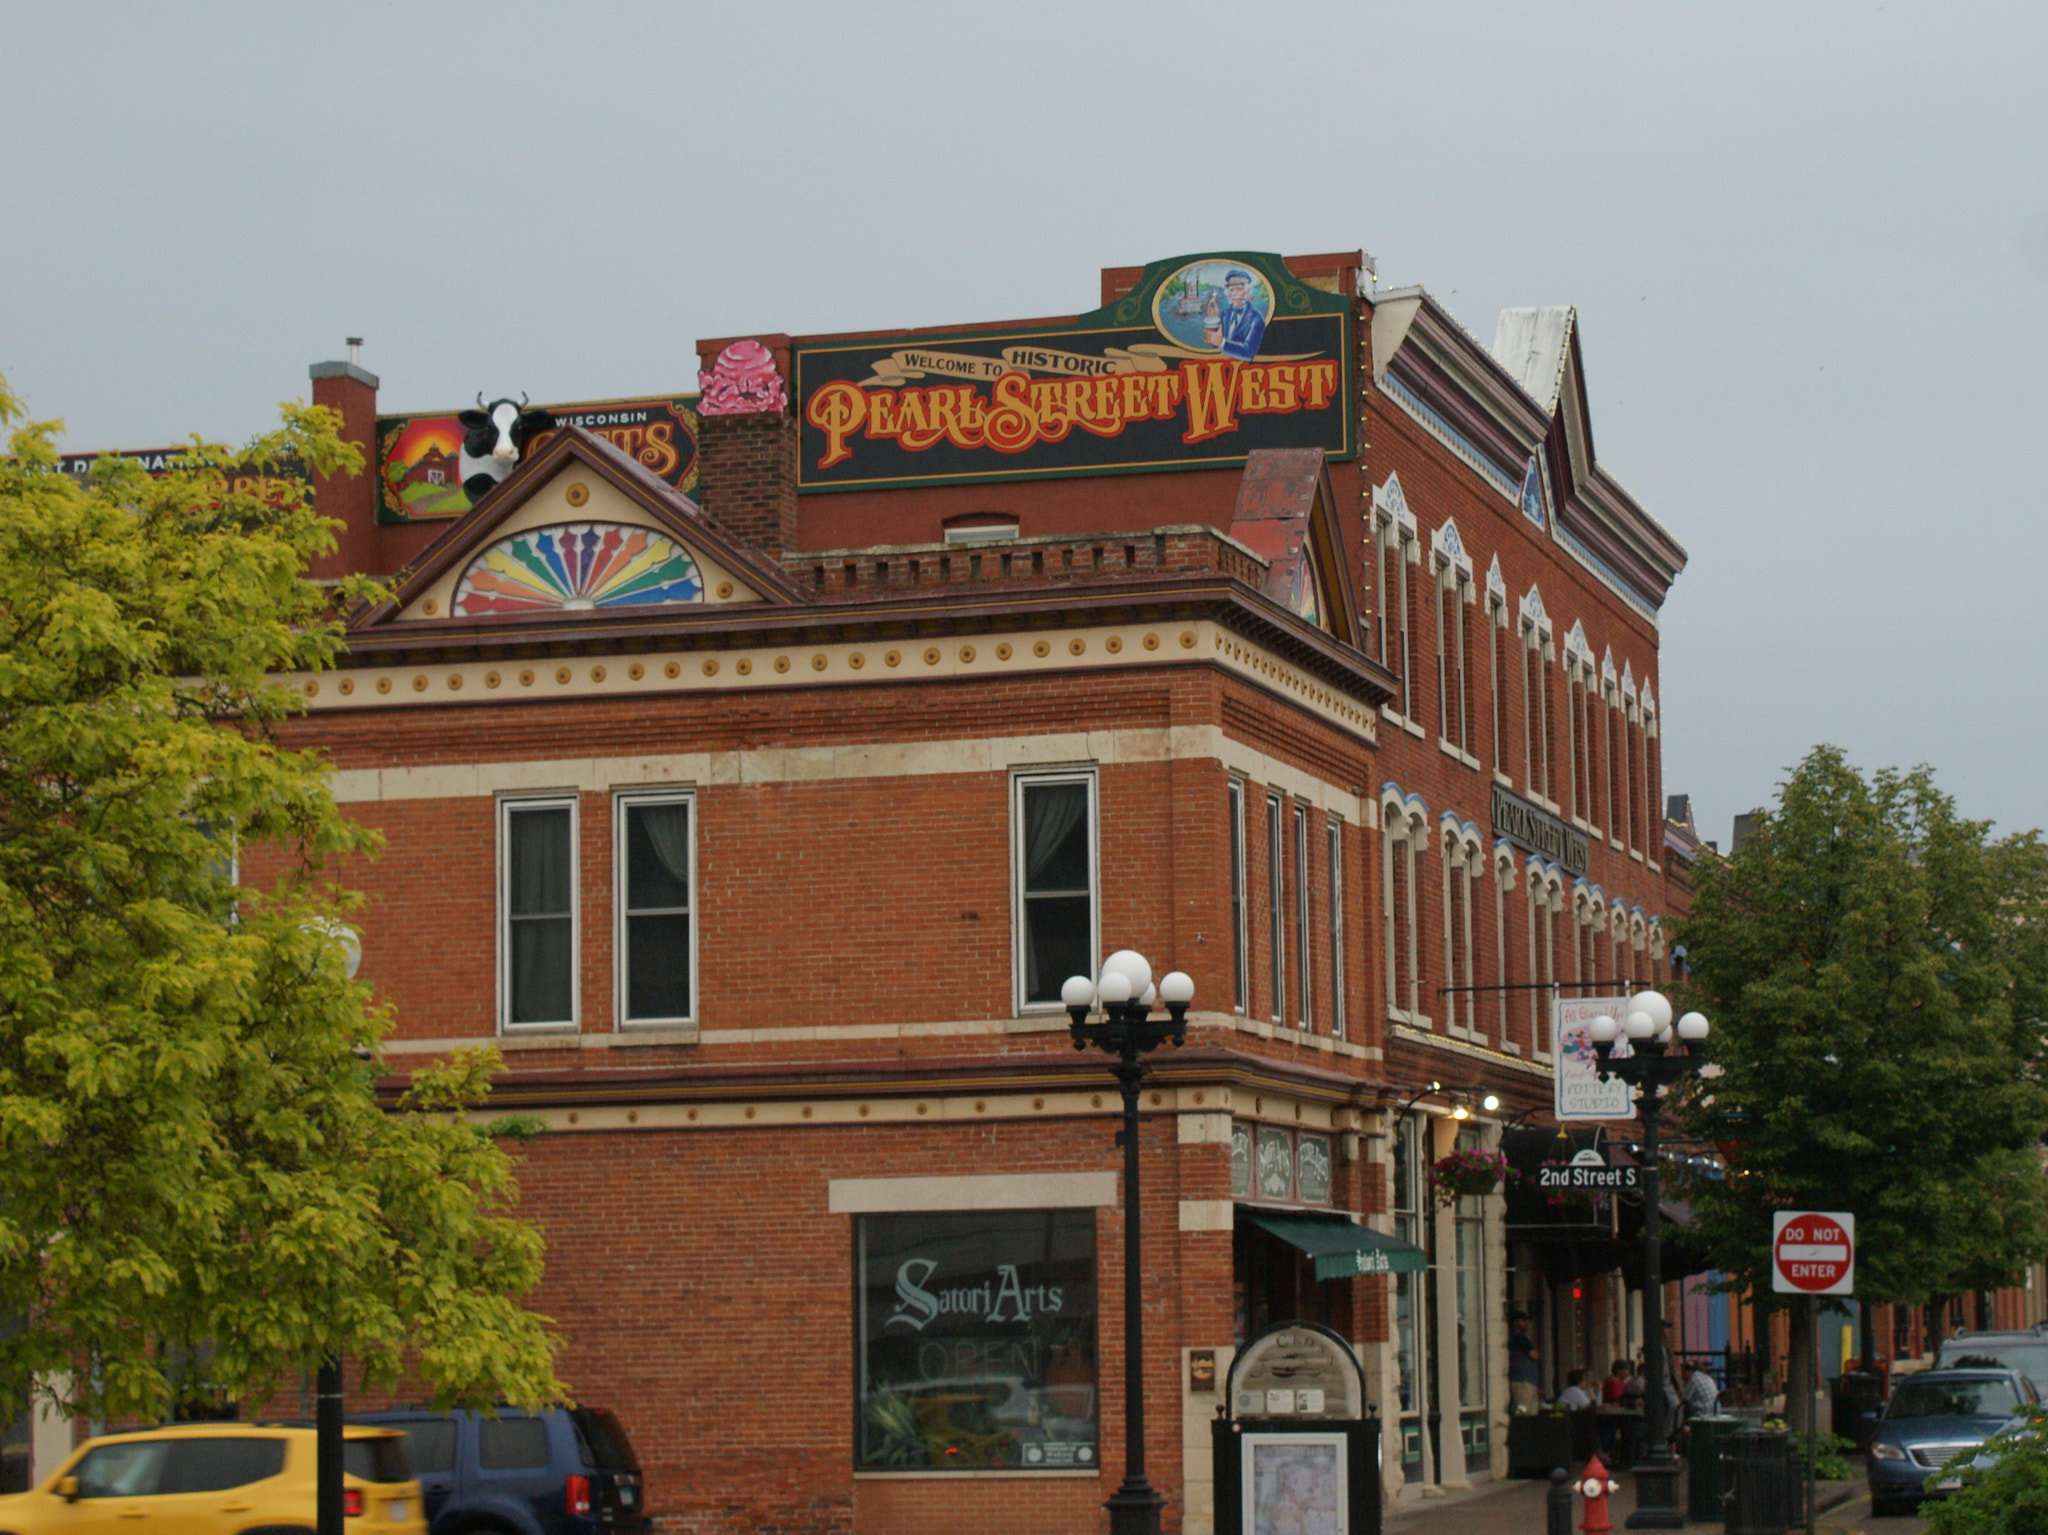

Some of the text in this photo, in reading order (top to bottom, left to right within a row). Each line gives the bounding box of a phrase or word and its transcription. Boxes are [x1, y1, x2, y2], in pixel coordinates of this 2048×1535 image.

[904, 353, 1003, 377] WELCOME TO
[1012, 350, 1117, 376] HISTORIC
[555, 411, 647, 427] WISCONSIN
[807, 359, 1338, 470] PEARL STREET WEST
[1568, 1083, 1621, 1095] POTTERY
[1569, 1097, 1619, 1108] STUDIO
[1540, 1168, 1636, 1186] 2nd Street S
[1785, 1228, 1840, 1241] DO NOT
[1791, 1264, 1835, 1278] ENTER
[885, 1258, 1063, 1331] Satori Arts
